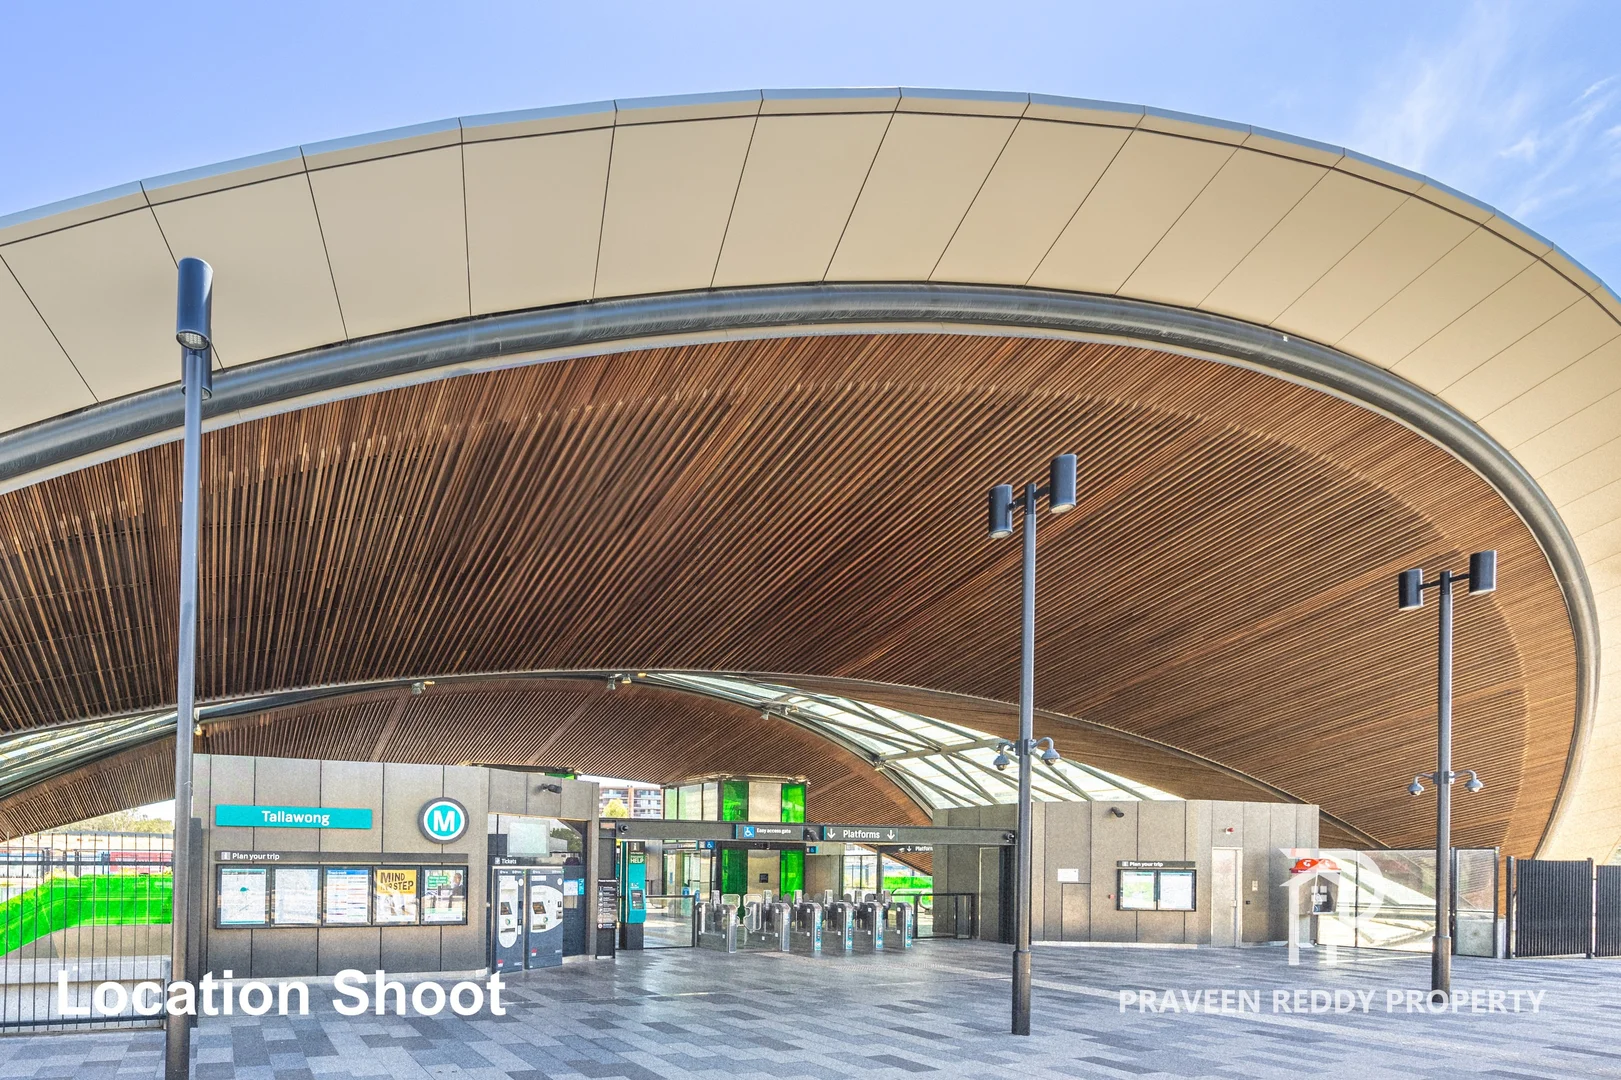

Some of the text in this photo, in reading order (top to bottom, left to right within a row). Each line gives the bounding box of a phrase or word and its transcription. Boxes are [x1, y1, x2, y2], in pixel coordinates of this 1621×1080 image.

[262, 810, 330, 826] Tallawong
[433, 810, 455, 832] M
[843, 829, 880, 839] Platforms
[249, 853, 267, 861] your
[268, 853, 280, 861] trip
[381, 872, 405, 883] MIND
[394, 880, 414, 890] STEP
